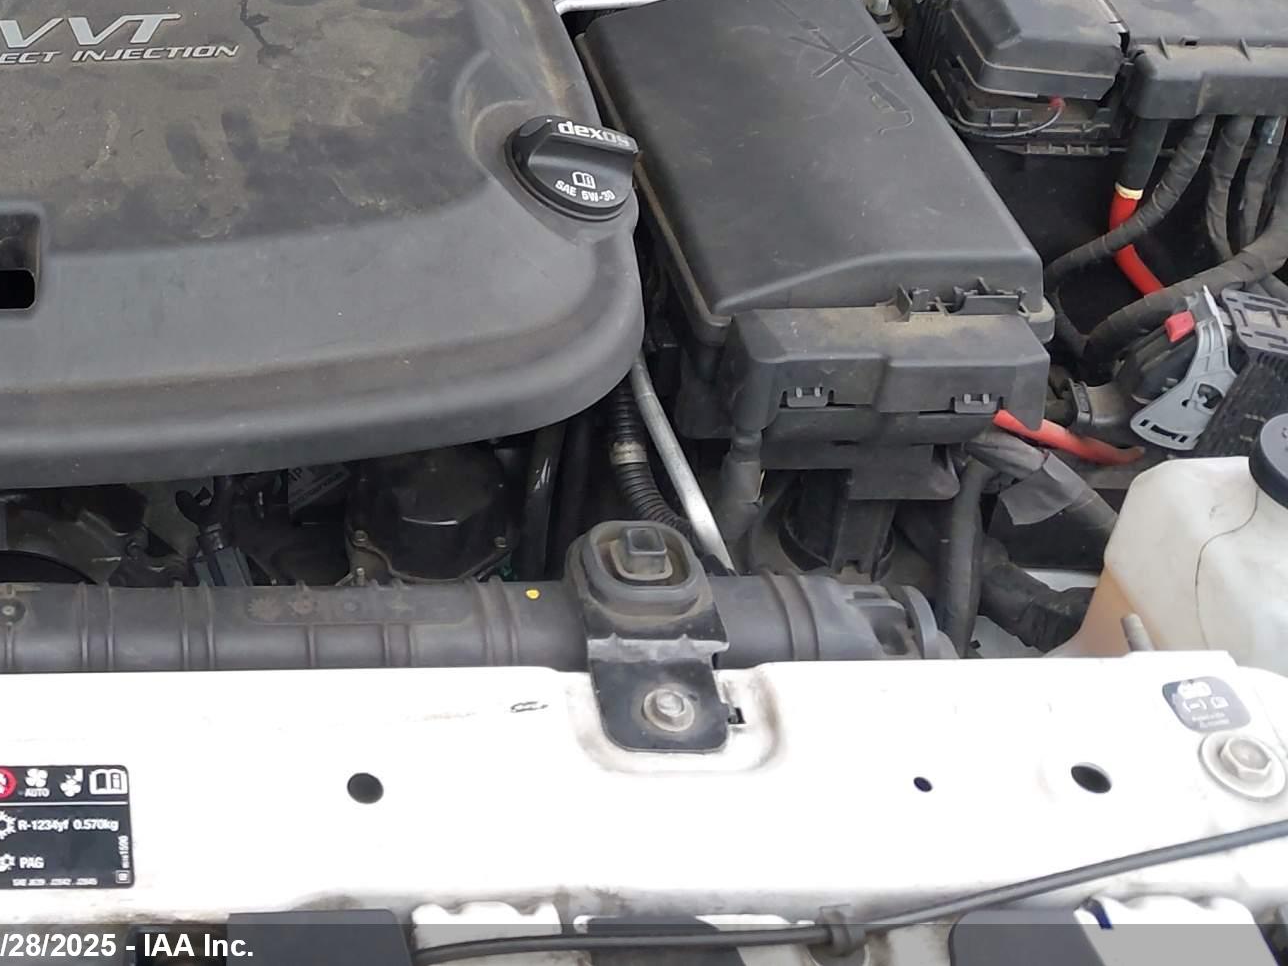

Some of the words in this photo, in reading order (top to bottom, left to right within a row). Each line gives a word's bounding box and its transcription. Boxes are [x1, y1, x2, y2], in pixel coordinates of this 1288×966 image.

[71, 44, 239, 63] INJECTION
[557, 121, 630, 147] dexos
[555, 180, 577, 197] SAE
[24, 788, 50, 798] AUTO
[17, 819, 70, 832] R-1234yf
[73, 819, 119, 831] 0.570kg
[19, 857, 45, 869] PAG
